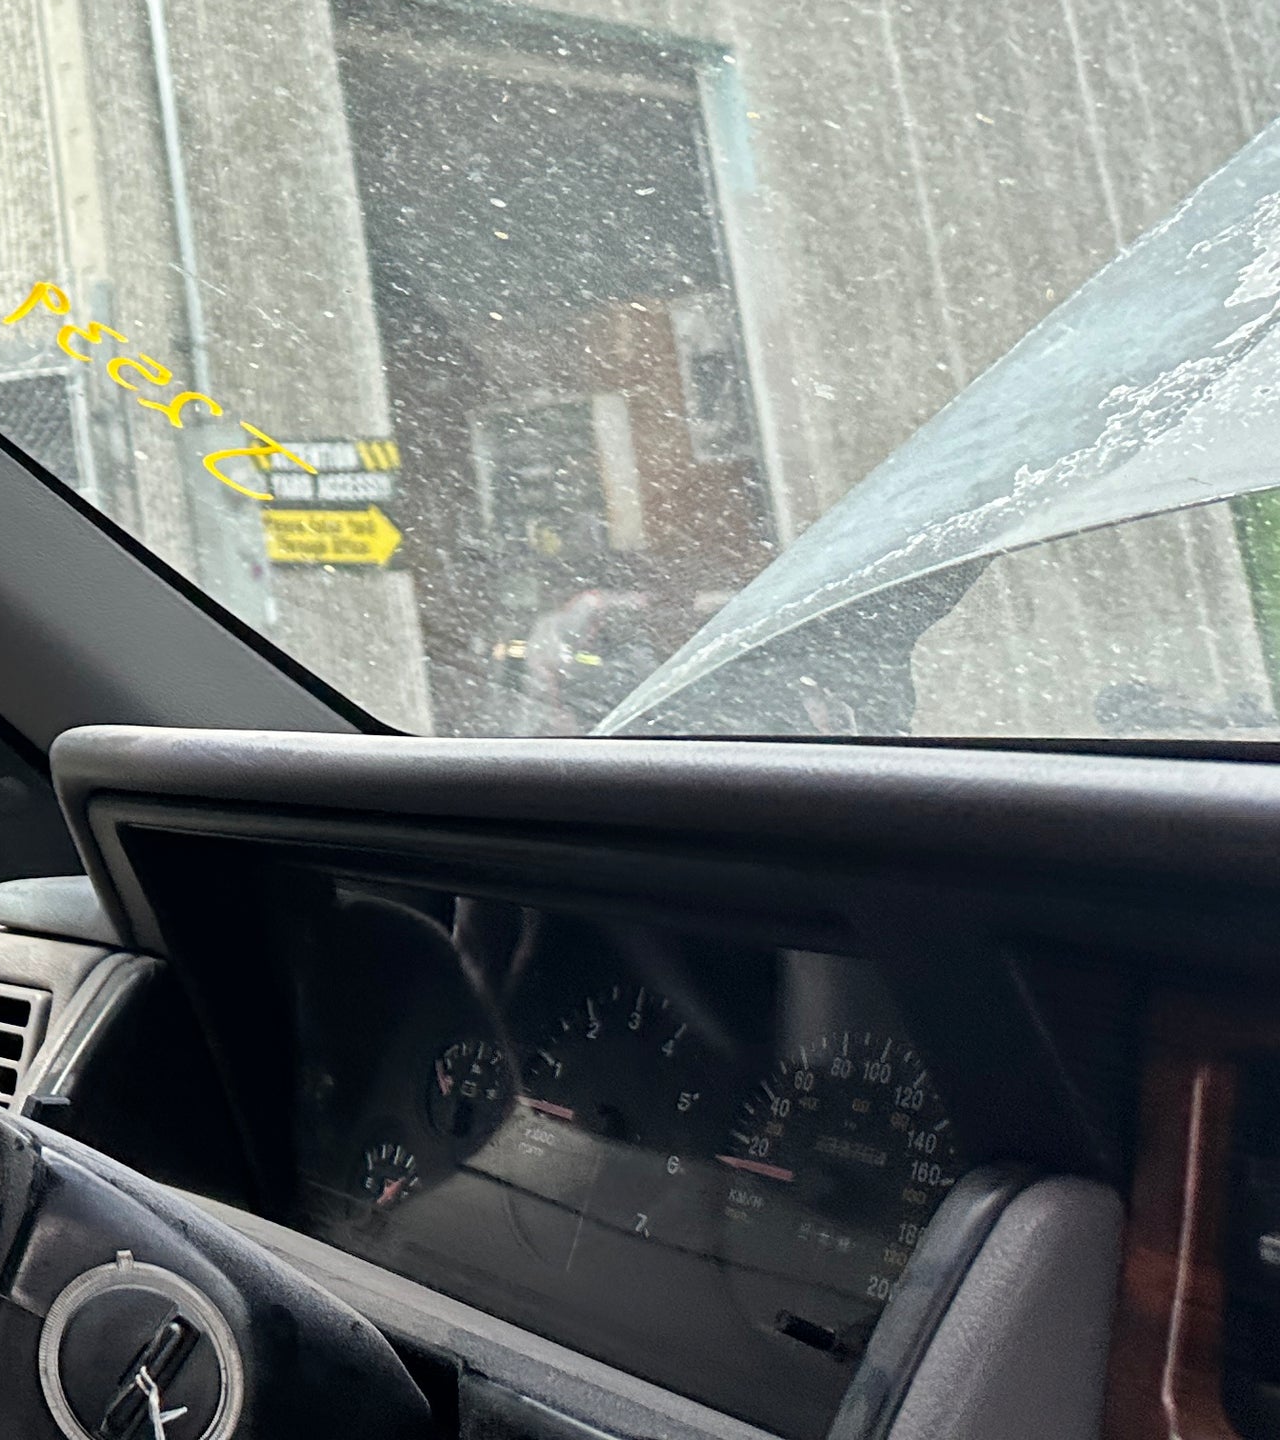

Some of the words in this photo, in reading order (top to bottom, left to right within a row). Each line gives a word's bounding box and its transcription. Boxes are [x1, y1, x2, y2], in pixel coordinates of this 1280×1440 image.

[793, 1069, 815, 1093] 60
[830, 1057, 852, 1079] 80
[863, 1058, 892, 1085] 100
[771, 1097, 791, 1118] 40
[894, 1084, 925, 1110] 120
[747, 1136, 771, 1158] 20
[907, 1129, 939, 1155] 140
[911, 1160, 942, 1187] 160
[866, 1275, 894, 1303] 20
